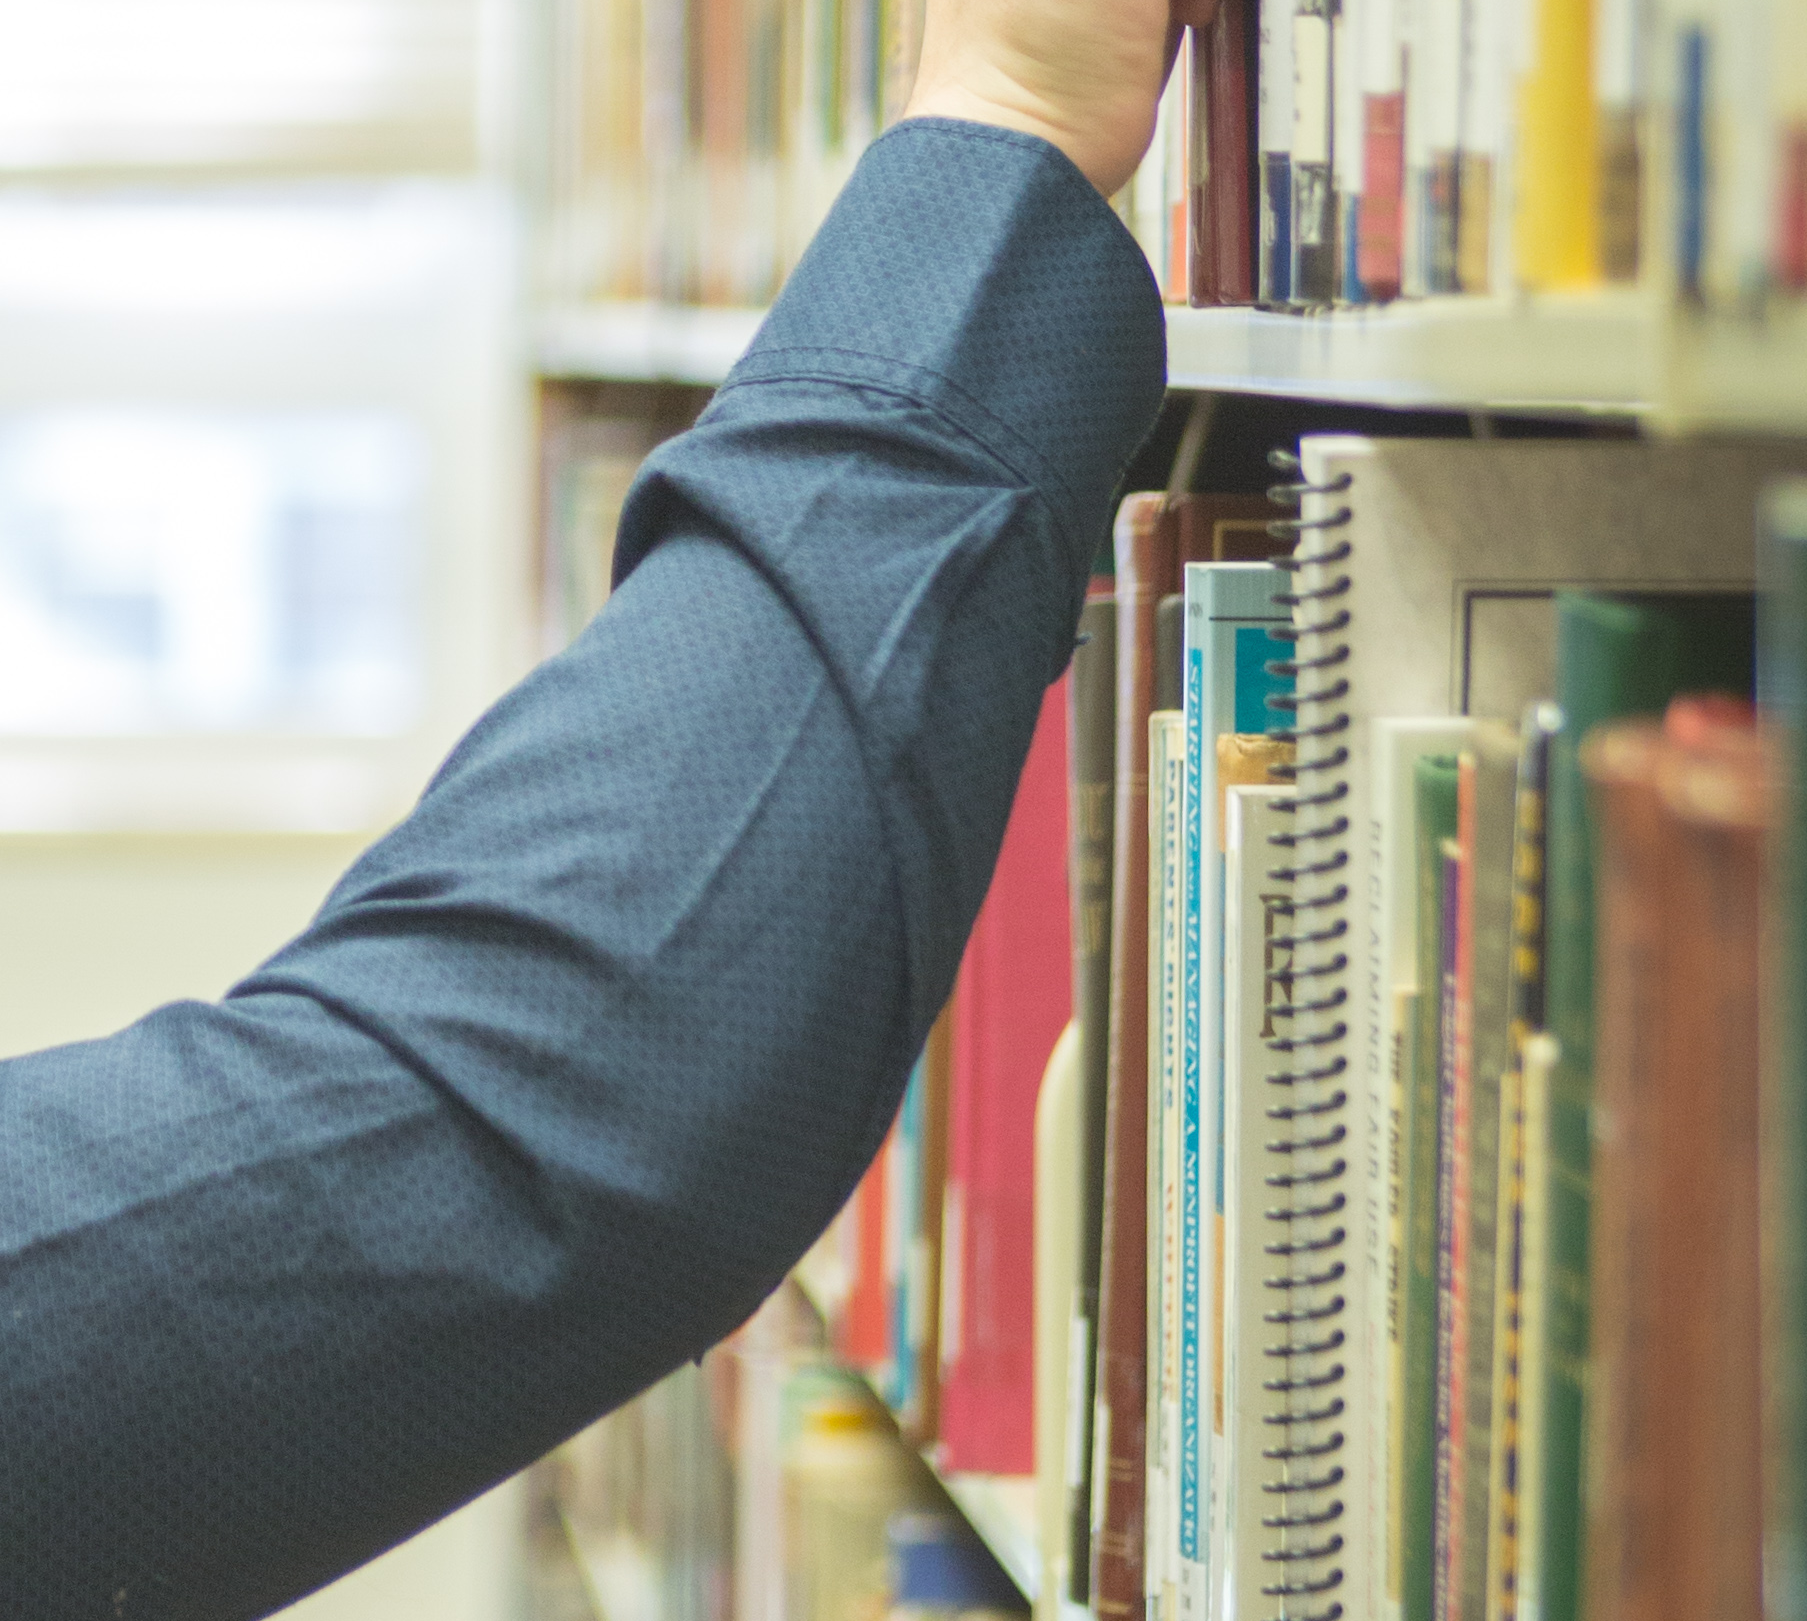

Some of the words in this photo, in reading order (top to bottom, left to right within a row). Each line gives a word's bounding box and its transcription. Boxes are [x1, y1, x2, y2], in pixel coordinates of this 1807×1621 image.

[1185, 665, 1199, 850] STARTING
[1185, 906, 1198, 1104] MANAGING
[1367, 818, 1383, 1075] RECLAIMING
[1366, 1091, 1381, 1184] FAIR
[1185, 1150, 1197, 1338] NONPROFIT
[1365, 1194, 1380, 1277] USE
[1184, 1344, 1196, 1558] ORGANIZATIO
